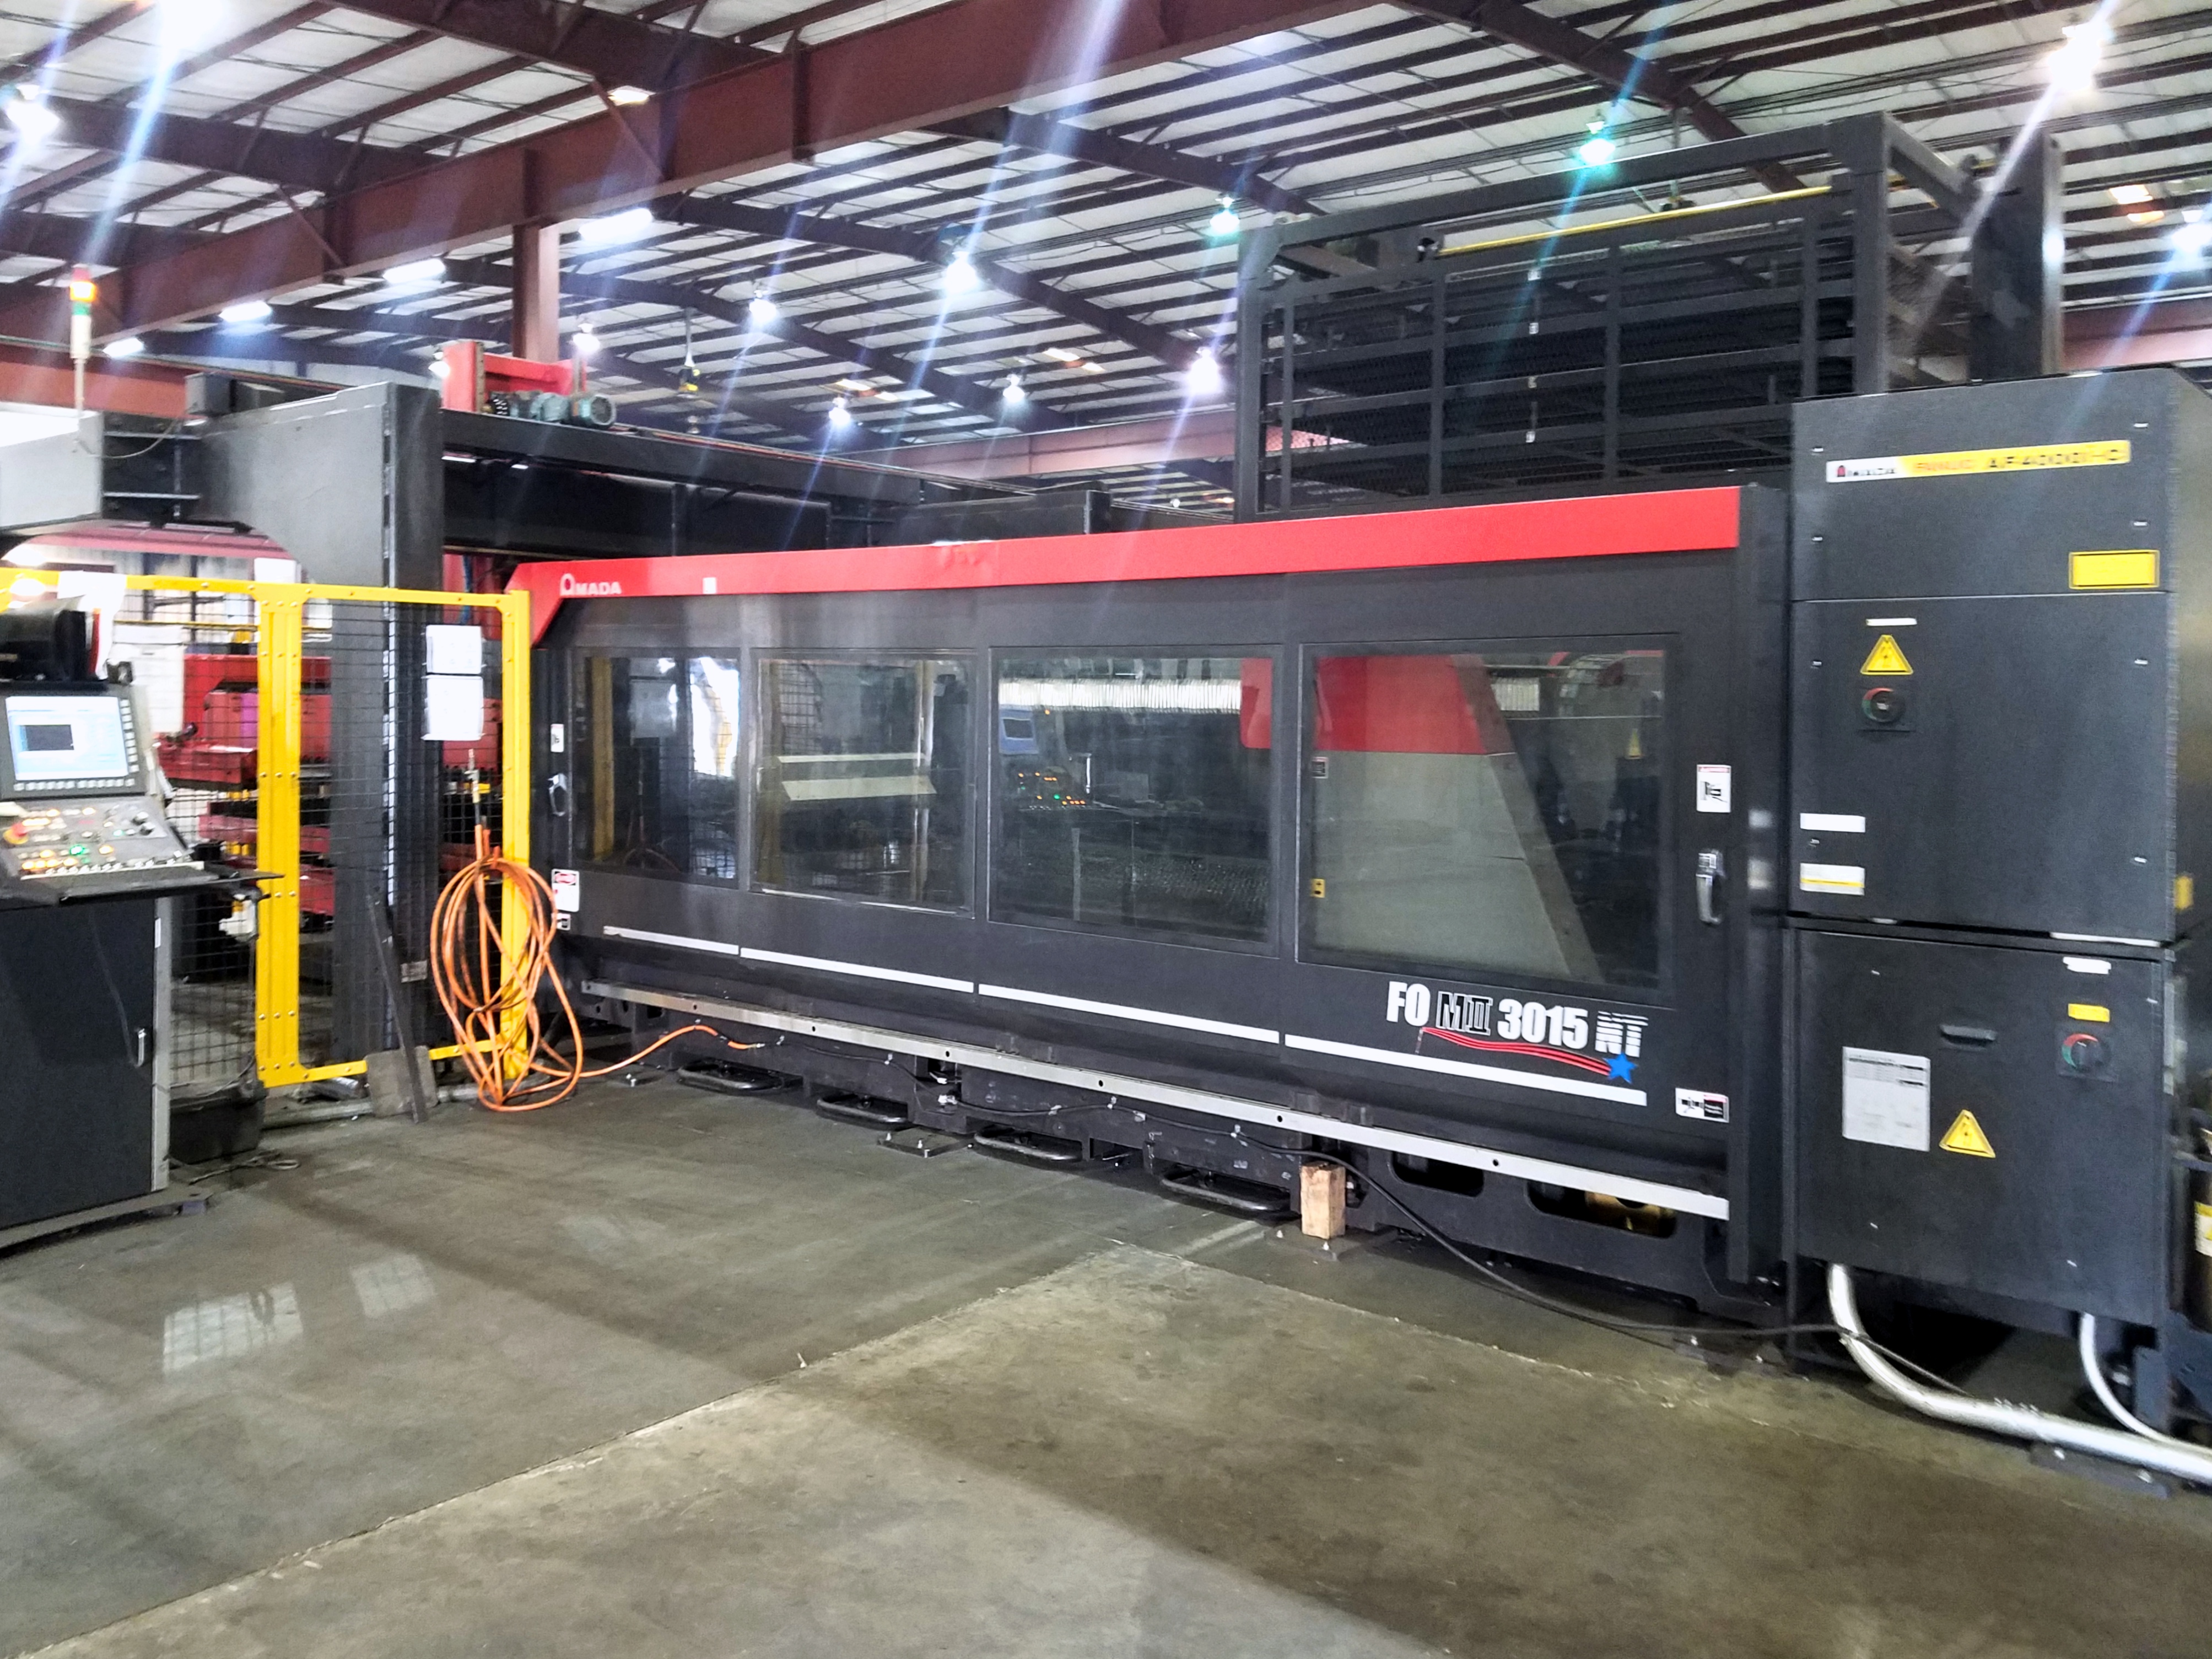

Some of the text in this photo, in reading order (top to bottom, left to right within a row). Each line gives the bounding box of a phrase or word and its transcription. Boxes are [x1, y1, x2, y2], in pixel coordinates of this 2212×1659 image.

[560, 573, 622, 596] AMADA
[1386, 981, 1431, 1026] FO
[1497, 999, 1588, 1049] 3015
[1595, 1011, 1649, 1057] NT
